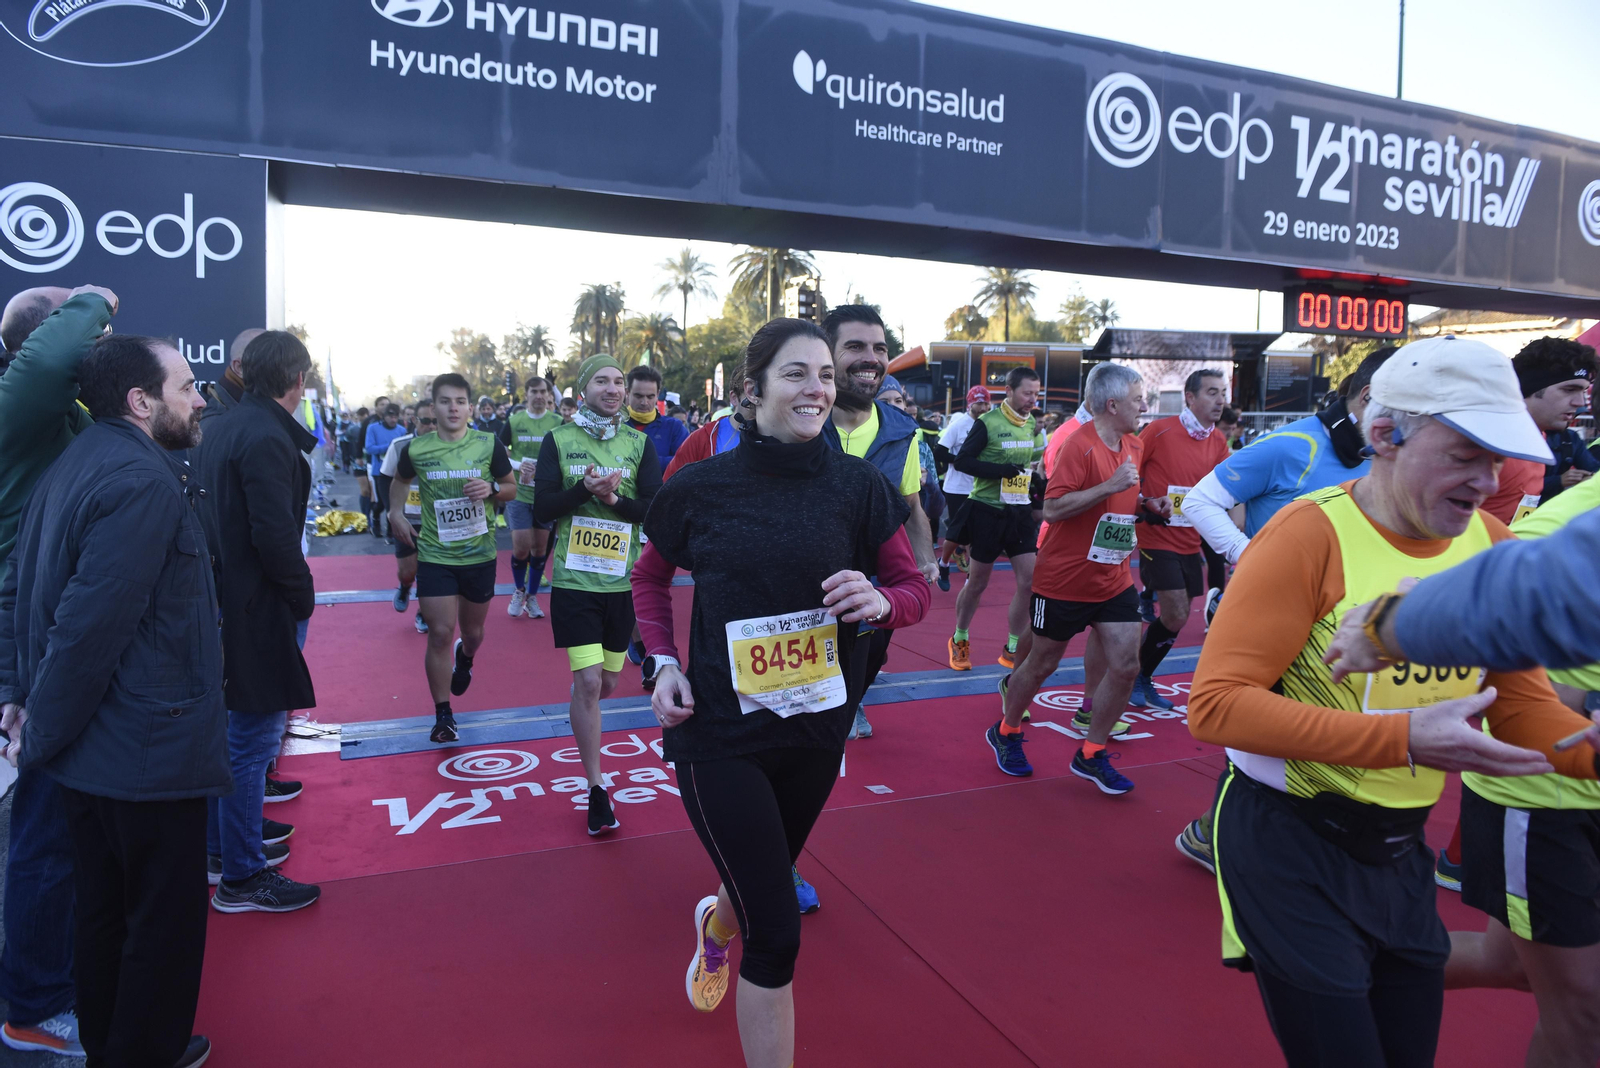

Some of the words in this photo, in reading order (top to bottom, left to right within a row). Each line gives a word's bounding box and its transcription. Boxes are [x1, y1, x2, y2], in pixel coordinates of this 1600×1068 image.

[466, 0, 659, 57] HYUNDAI
[370, 39, 558, 90] Hyundauto
[565, 66, 657, 103] Motor
[825, 73, 1005, 123] quirónsalud
[855, 118, 943, 148] Healthcare
[946, 131, 1004, 156] Partner
[1167, 91, 1274, 181] edp
[1341, 124, 1505, 187] maratón
[1383, 174, 1504, 228] sevilla
[95, 192, 243, 279] edp
[1262, 209, 1289, 235] 29
[1293, 219, 1351, 244] enero
[1355, 221, 1400, 250] 2023
[1297, 292, 1332, 329] 00
[1336, 295, 1369, 332] 00
[1373, 299, 1404, 334] 00
[426, 469, 448, 480] MEDIO
[448, 466, 482, 479] MARATÓN
[566, 452, 588, 460] HOKA
[569, 464, 595, 476] MED
[439, 505, 478, 524] 12501
[574, 528, 621, 552] 10502
[1103, 525, 1132, 544] 6425
[755, 621, 776, 633] edp
[749, 634, 819, 676] 8454
[759, 683, 784, 692] Carmen
[793, 685, 810, 697] edp
